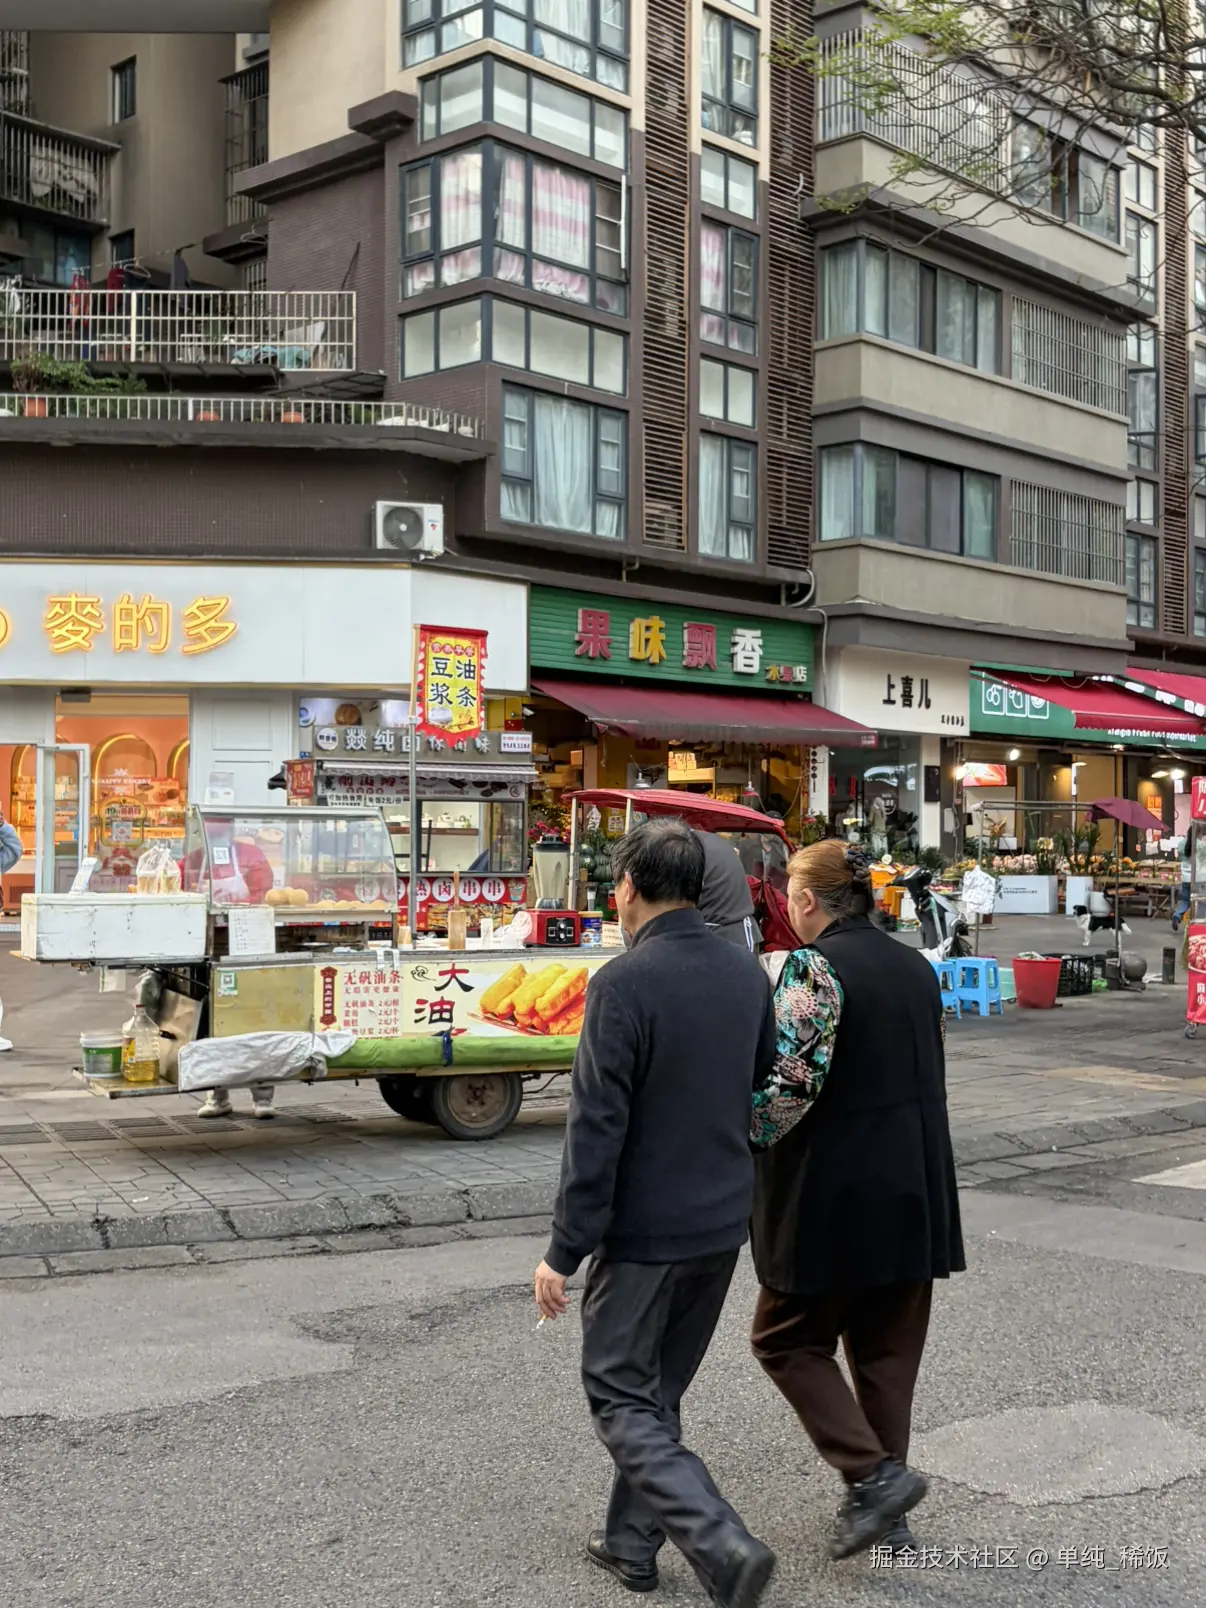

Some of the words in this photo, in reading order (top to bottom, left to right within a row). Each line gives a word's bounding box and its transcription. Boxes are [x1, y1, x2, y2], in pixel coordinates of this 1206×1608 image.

[44, 591, 238, 655] 麥的多
[575, 608, 764, 675] 果味飘香
[428, 656, 453, 706] 豆浆
[455, 658, 477, 708] 油条
[765, 663, 808, 683] 水果店
[882, 672, 932, 710] 上喜儿
[343, 970, 401, 985] 无矾油条
